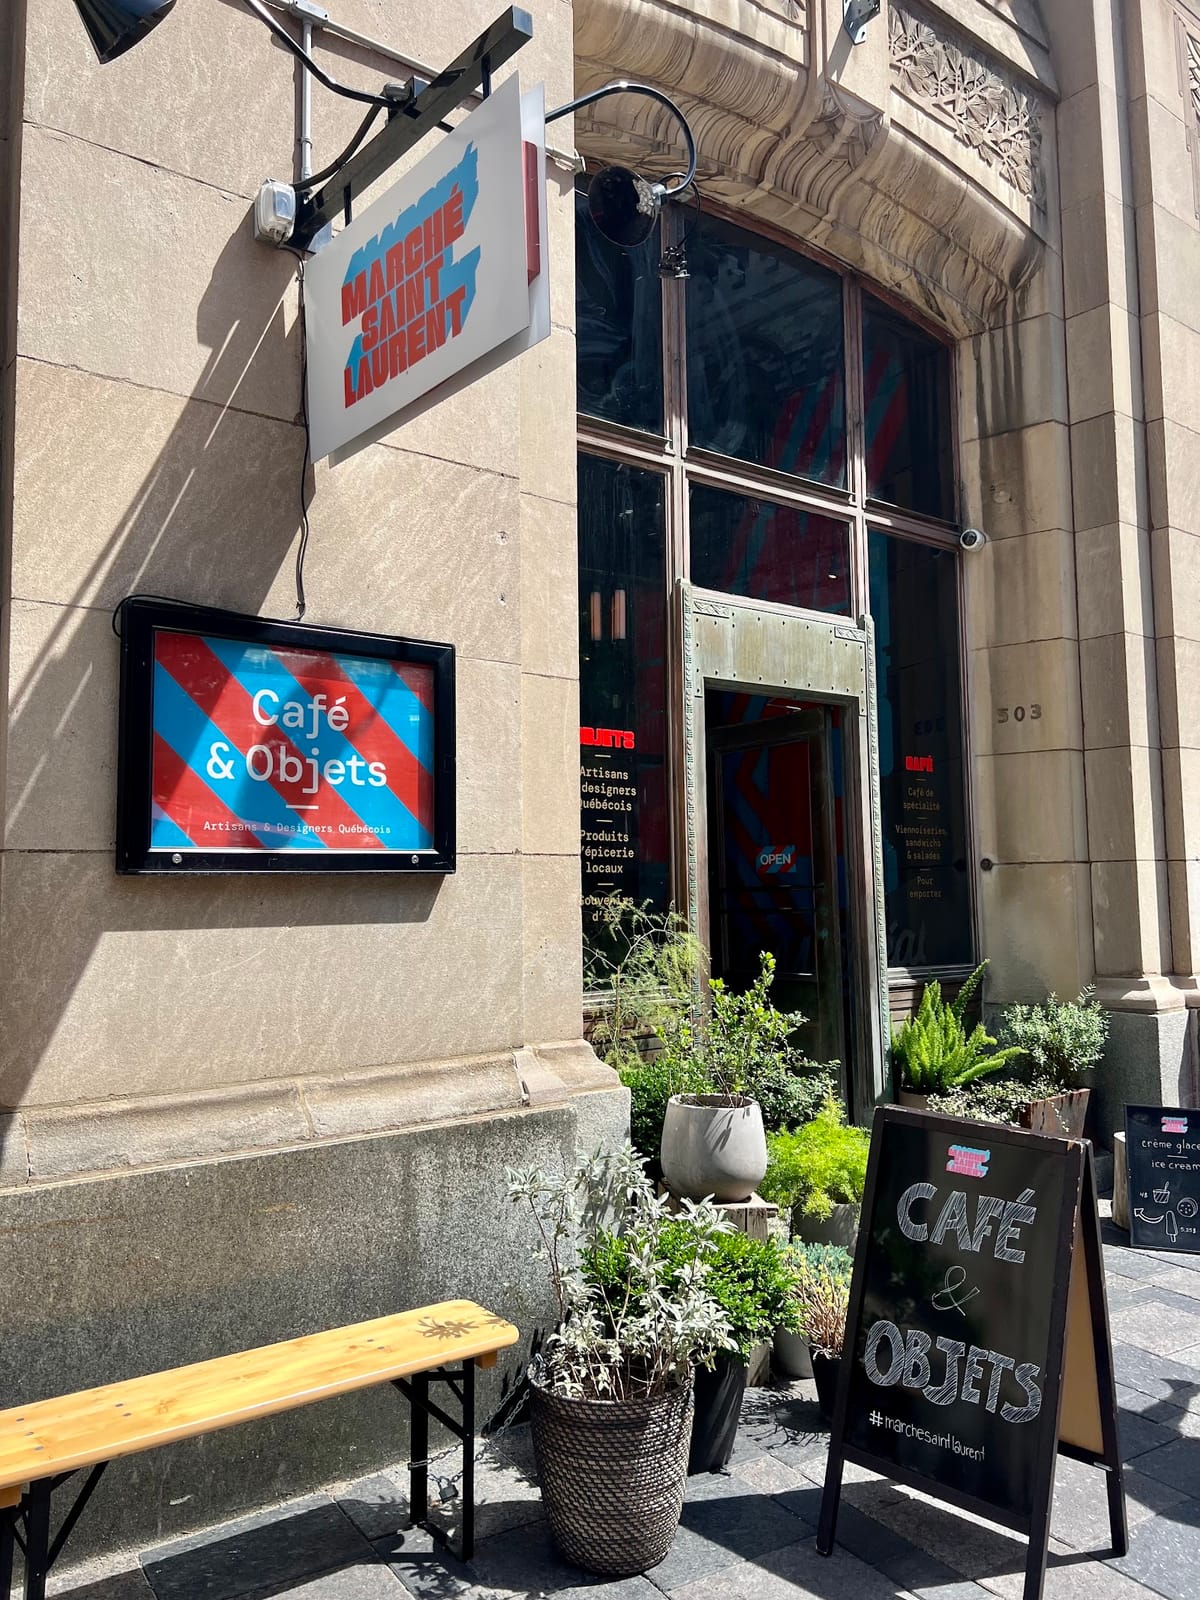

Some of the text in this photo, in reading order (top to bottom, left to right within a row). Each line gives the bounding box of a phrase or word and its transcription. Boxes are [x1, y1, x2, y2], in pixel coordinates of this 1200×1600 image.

[341, 184, 464, 326] MARCHÉ
[361, 255, 444, 351] SAINT
[344, 285, 466, 409] LAURENT
[252, 689, 350, 740] Café
[997, 704, 1042, 723] 503
[206, 742, 388, 794] & Objets
[580, 765, 629, 780] Artisans
[582, 782, 637, 797] designers
[907, 787, 933, 798] Café de
[903, 802, 940, 812] spécialité
[203, 821, 391, 834] Artisans & Designers Québécois
[580, 830, 630, 842] Produits
[581, 846, 635, 862] 'épicerie
[762, 854, 791, 865] OPEN
[914, 853, 941, 862] salades
[585, 862, 624, 874] locaux
[916, 876, 934, 885] Pour
[1141, 1139, 1172, 1149] crème
[1151, 1160, 1166, 1169] ice
[896, 1181, 1037, 1264] CAFÉ
[931, 1265, 981, 1317] &
[863, 1319, 1043, 1424] OBJETS
